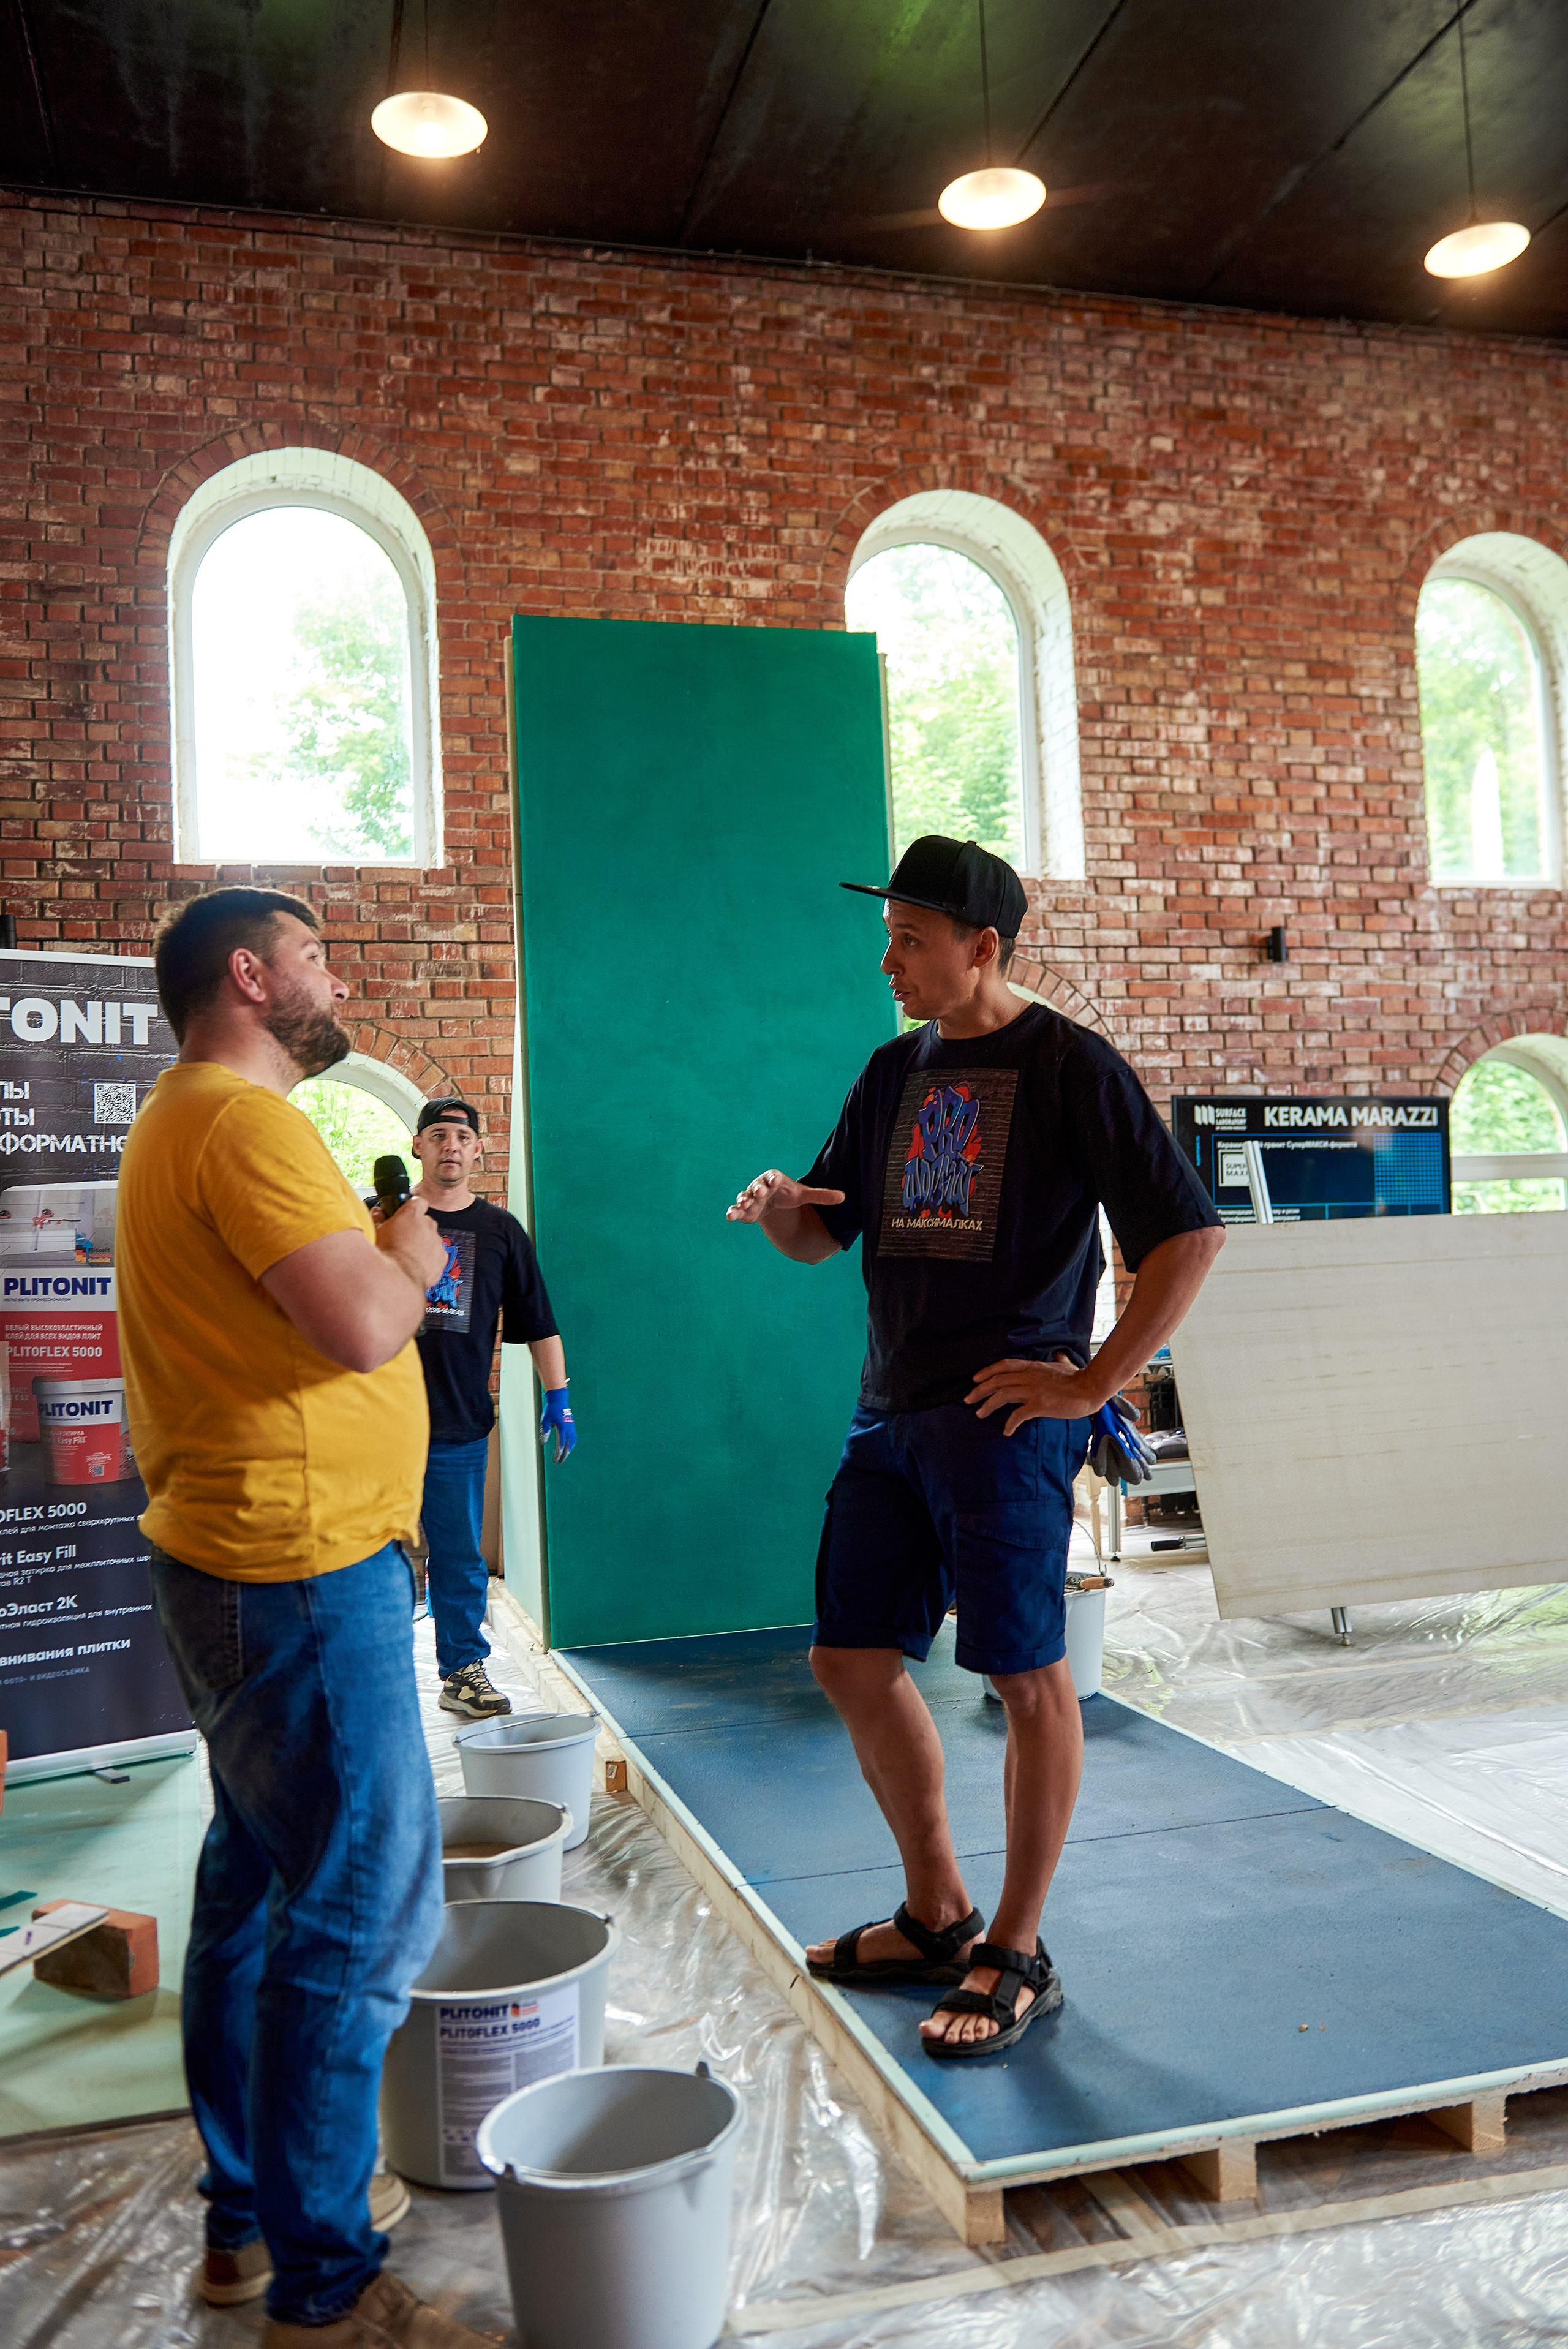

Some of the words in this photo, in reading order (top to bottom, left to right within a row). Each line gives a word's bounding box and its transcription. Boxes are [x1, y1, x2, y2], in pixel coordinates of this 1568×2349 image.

[1264, 1106, 1349, 1127] KERAMA
[1350, 1106, 1438, 1127] MARAZZI
[892, 1218, 905, 1229] НА
[907, 1217, 983, 1231] МАКСИМАЛКАХ
[4, 1277, 112, 1295] PLITONIT
[6, 1346, 70, 1358] PLITOFLEX
[72, 1346, 103, 1358] 5000
[39, 1400, 114, 1417] PLITONIT
[48, 1501, 87, 1518] 5000
[17, 1550, 53, 1564] Easy
[56, 1544, 77, 1559] Fill
[77, 1638, 132, 1656] плитки
[440, 2004, 509, 2020] PLITONIT
[440, 2025, 507, 2039] PLITOFLEX
